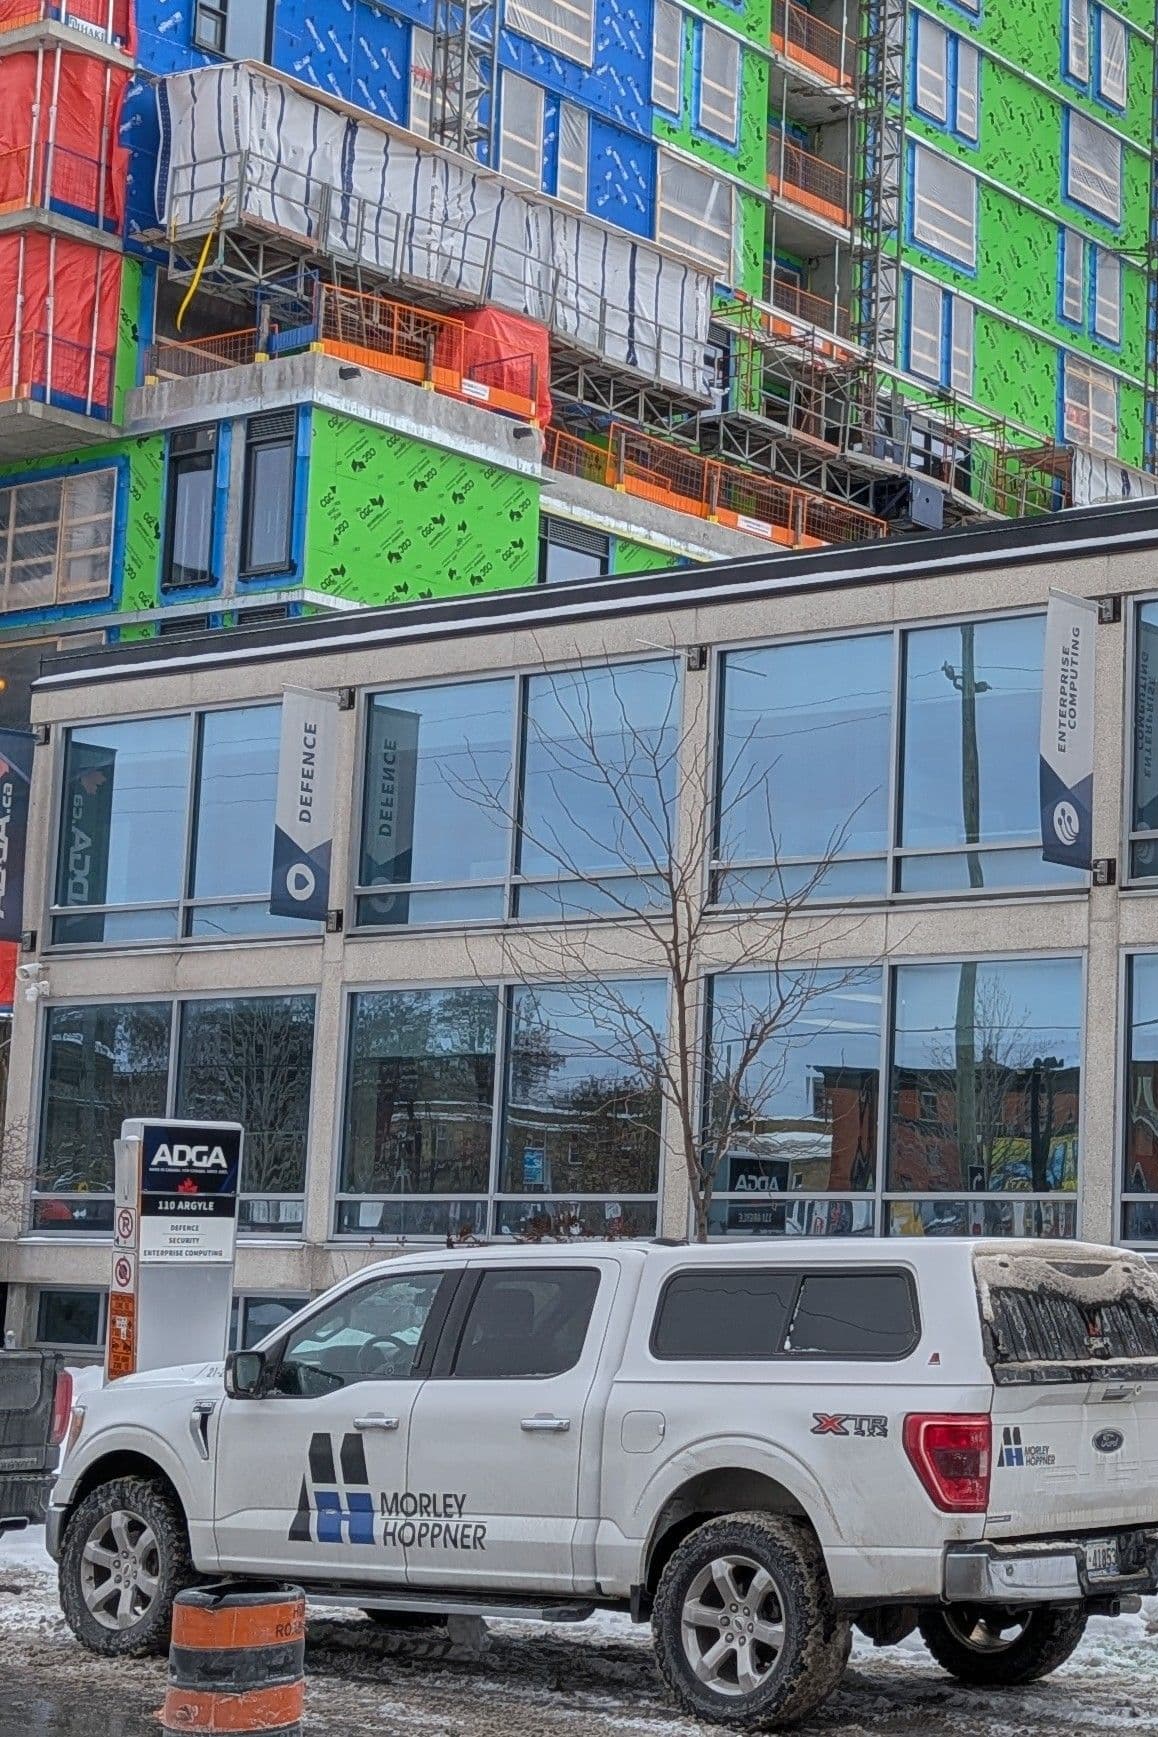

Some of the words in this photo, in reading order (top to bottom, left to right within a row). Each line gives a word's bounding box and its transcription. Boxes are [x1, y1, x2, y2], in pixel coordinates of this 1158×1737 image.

[1068, 626, 1080, 730] COMPUTING
[1057, 646, 1070, 753] ENTERPRISE
[299, 722, 317, 823] DEFENCE
[150, 1143, 229, 1168] ADGA
[158, 1200, 176, 1211] 110
[177, 1201, 215, 1211] ARGYLE
[1025, 1446, 1050, 1456] MORLEY
[380, 1492, 467, 1518] MORLEY
[383, 1521, 488, 1550] HOPPNER
